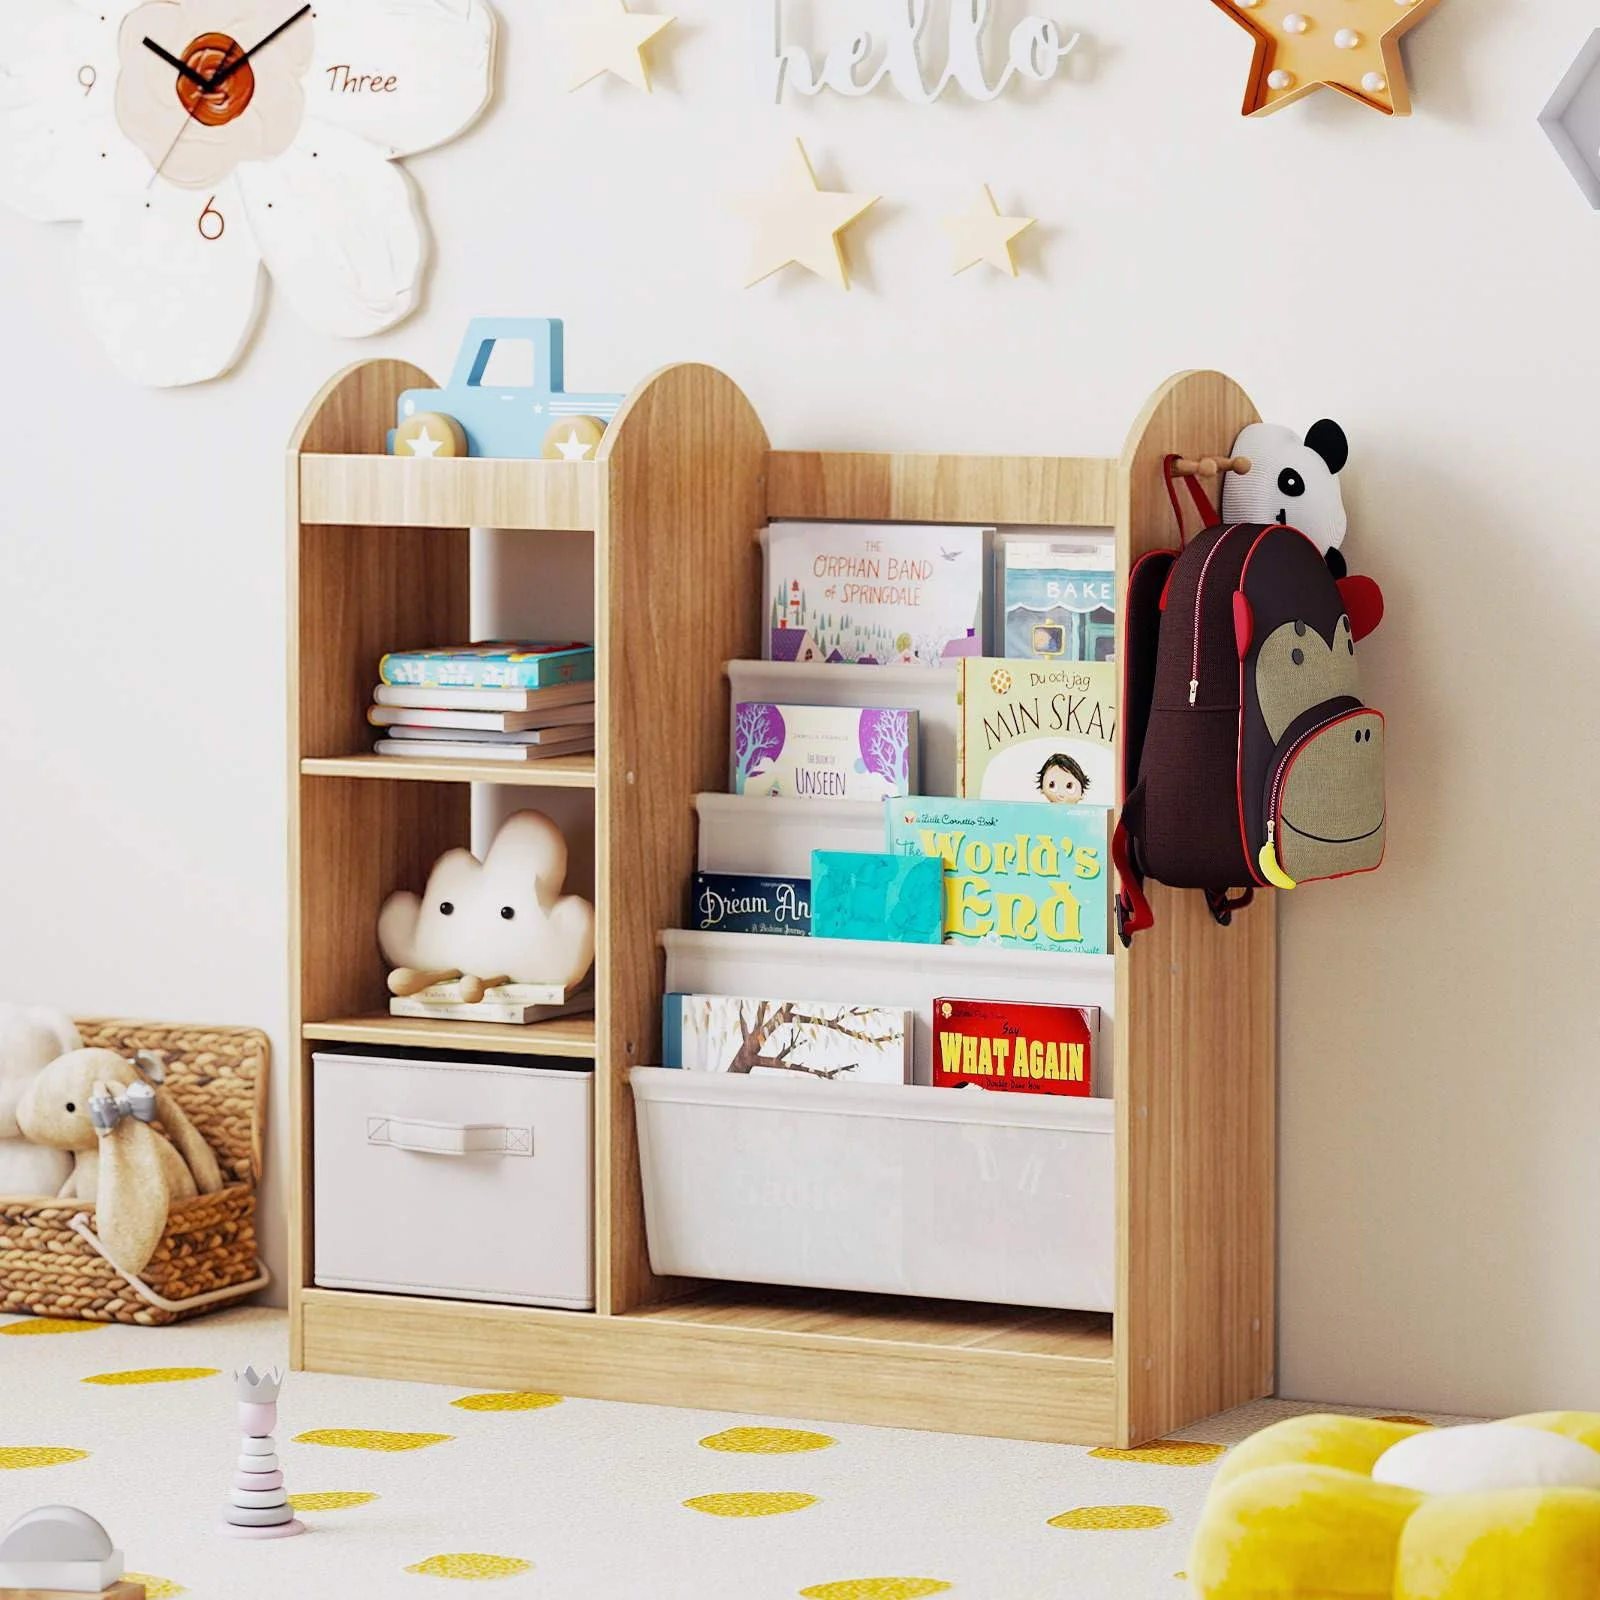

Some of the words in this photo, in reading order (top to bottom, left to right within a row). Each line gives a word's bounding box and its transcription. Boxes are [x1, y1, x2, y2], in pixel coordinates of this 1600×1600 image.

[774, 0, 1080, 104] hello
[77, 64, 97, 97] 9
[326, 64, 398, 93] Three
[198, 195, 225, 241] 6
[865, 540, 882, 553] THE
[813, 554, 880, 578] ORPHAN
[887, 558, 934, 580] BAND
[824, 585, 837, 600] of
[840, 583, 921, 606] SPRINGDALE
[1046, 581, 1112, 600] BAKE
[1030, 672, 1046, 687] Du
[1048, 670, 1067, 683] och
[1066, 671, 1091, 692] jag
[983, 697, 1040, 750] MIN
[795, 767, 846, 796] UNSEEN
[941, 813, 976, 826] Cornetto
[918, 828, 1101, 880] World's
[699, 886, 771, 929] Dream
[944, 876, 1084, 943] End
[1002, 1021, 1020, 1036] Say
[939, 1031, 1010, 1077] WHAT
[1012, 1036, 1084, 1082] AGAIN
